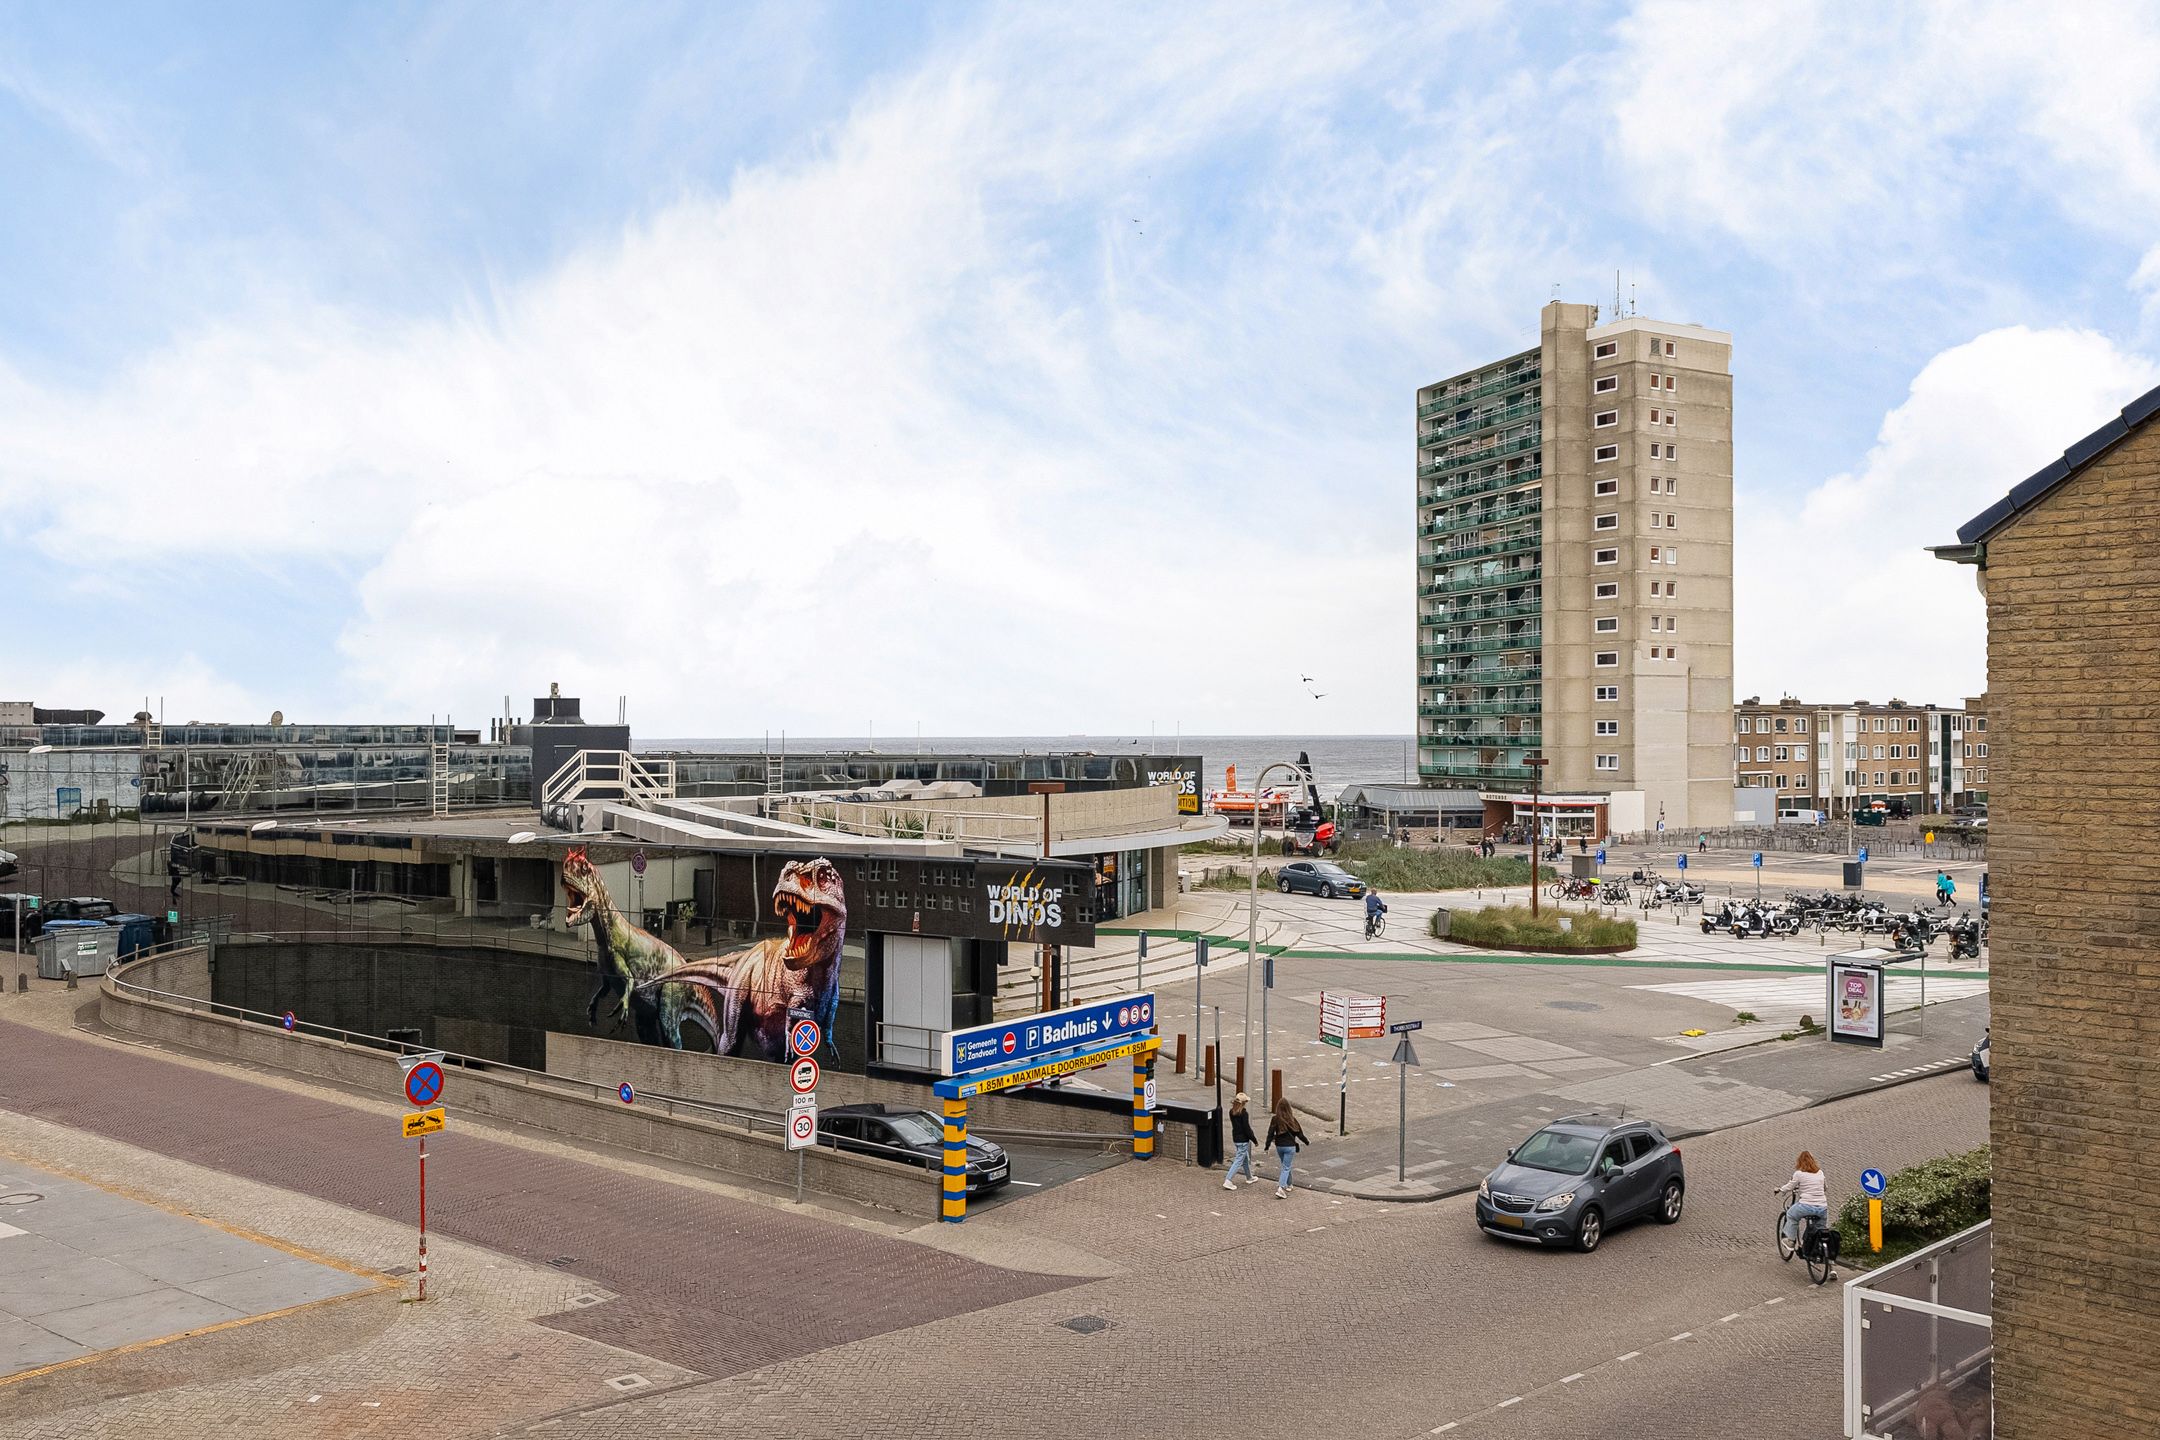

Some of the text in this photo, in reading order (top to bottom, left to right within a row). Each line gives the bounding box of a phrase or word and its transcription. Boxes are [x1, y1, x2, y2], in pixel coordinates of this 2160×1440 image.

[1147, 771, 1196, 781] WORLD OF
[987, 885, 1062, 902] WORLD OF
[989, 900, 1062, 927] DINOS
[1132, 1009, 1137, 1020] 5
[1028, 1017, 1098, 1047] P Badhuis
[967, 1037, 998, 1050] Gemeente
[967, 1046, 998, 1061] Zandvoort
[979, 1077, 1004, 1092] 1.85M
[1012, 1064, 1056, 1084] MAXIMALE
[1057, 1048, 1120, 1074] DOORRIJHOOGTE
[1126, 1041, 1147, 1055] 1.85M
[797, 1122, 810, 1132] 30
